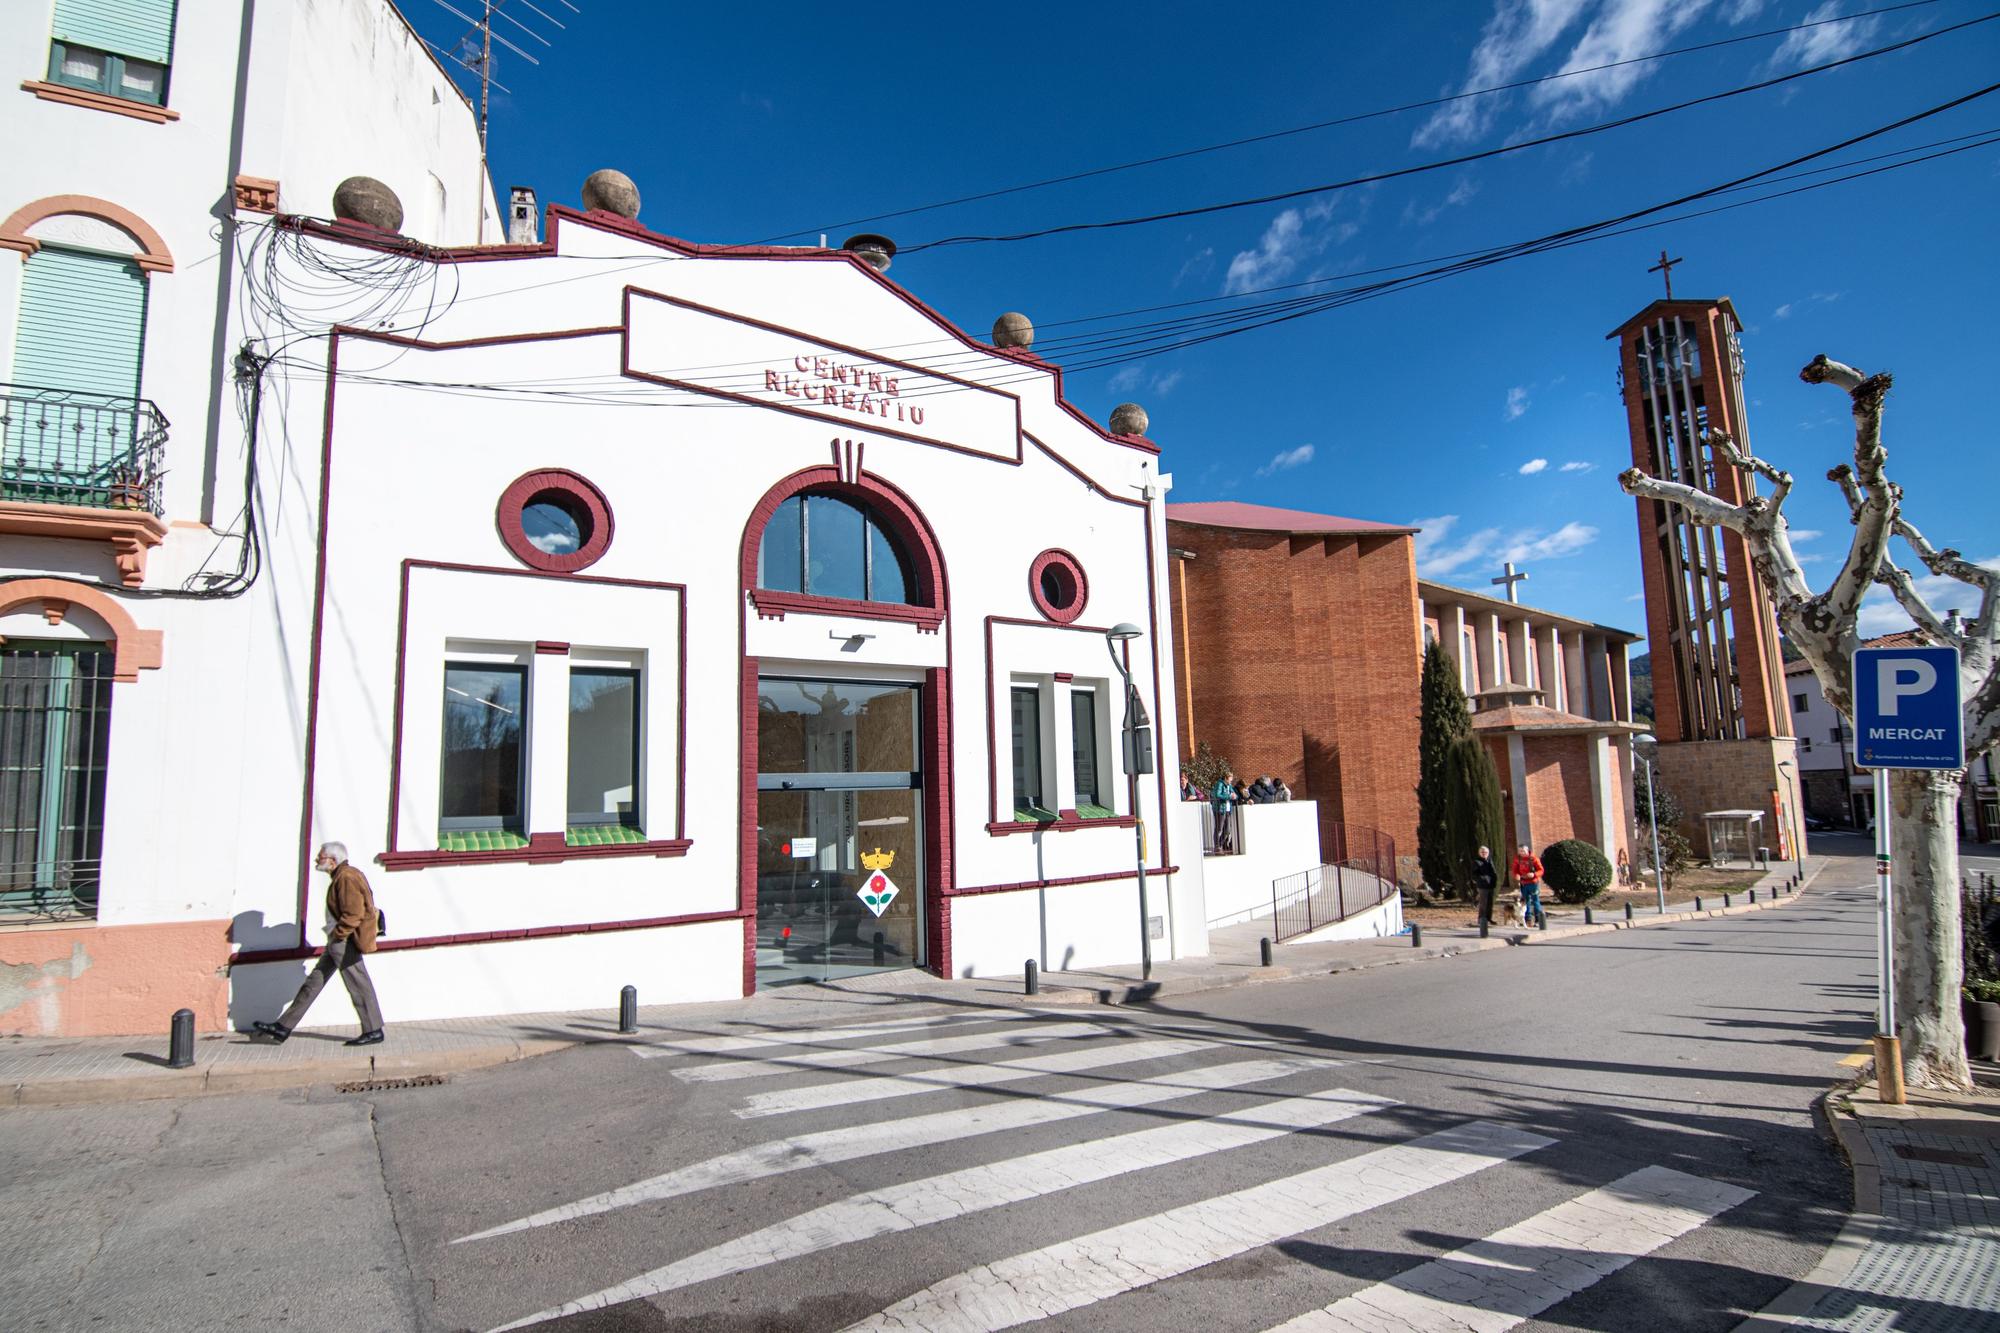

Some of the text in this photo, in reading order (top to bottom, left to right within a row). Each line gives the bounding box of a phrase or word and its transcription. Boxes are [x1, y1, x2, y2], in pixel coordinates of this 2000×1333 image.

[765, 369, 924, 425] RECREATIU
[794, 355, 899, 396] CENTRE
[1877, 659, 1937, 716] P
[1869, 728, 1946, 740] MERCAT
